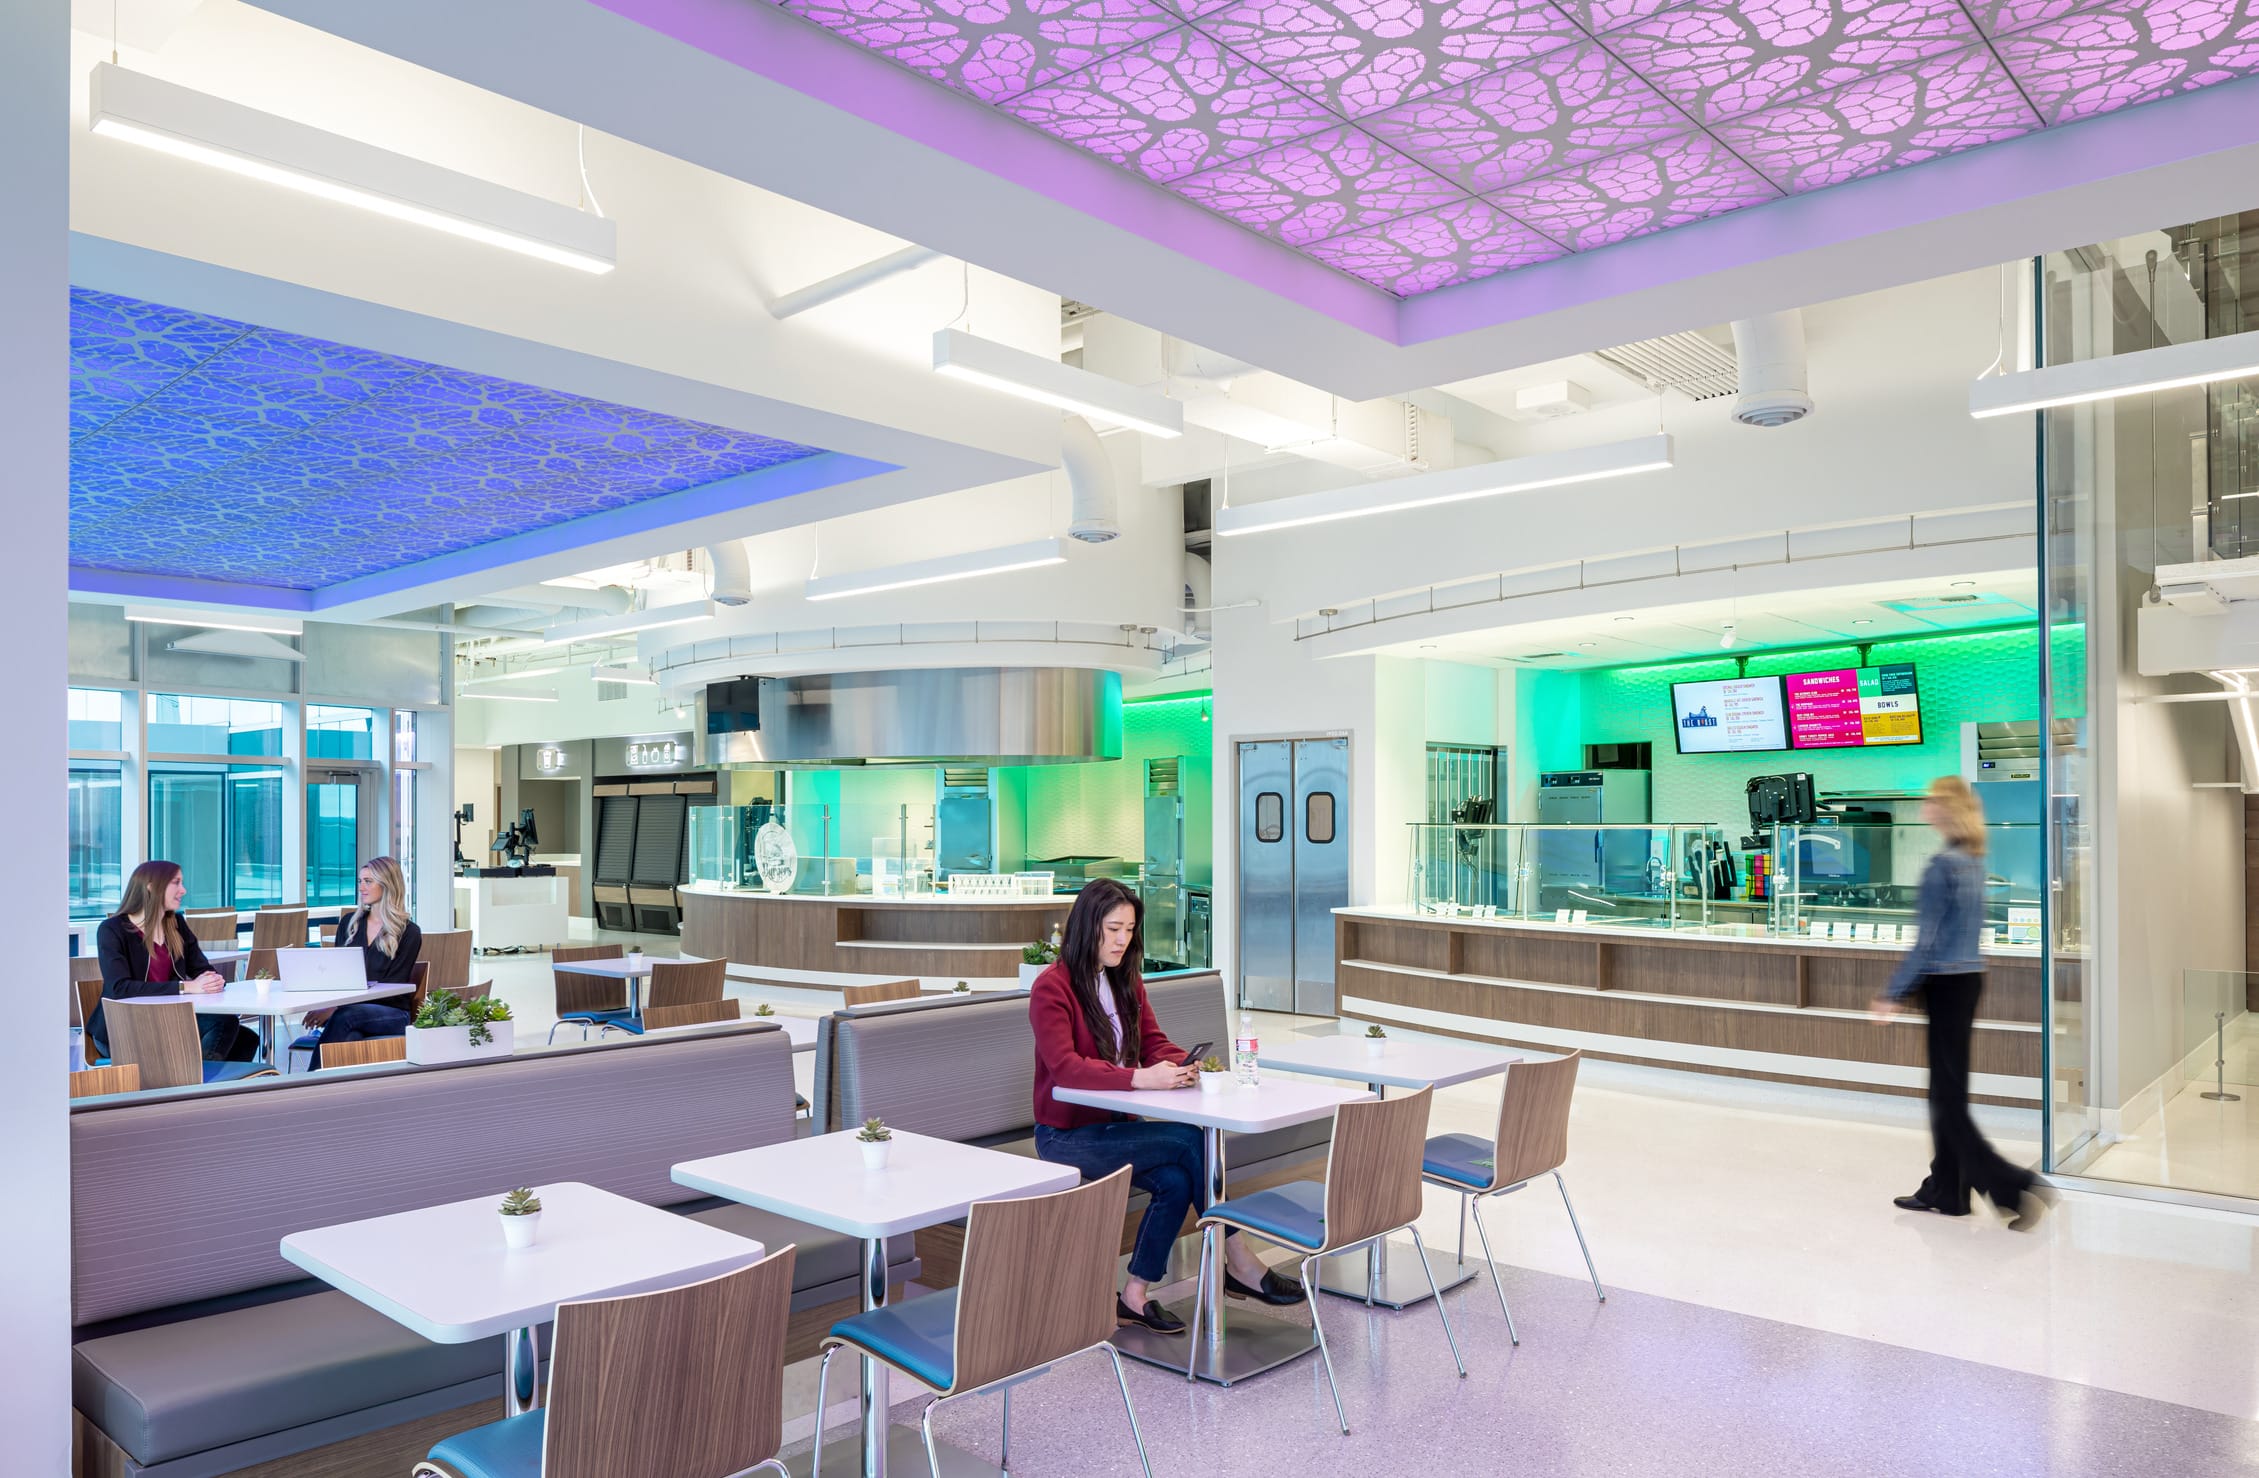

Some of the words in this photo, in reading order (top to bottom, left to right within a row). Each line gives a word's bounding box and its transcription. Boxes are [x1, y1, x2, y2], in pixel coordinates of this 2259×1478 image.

[1802, 676, 1840, 686] SANDWICHES
[1859, 679, 1879, 687] SALAD
[1877, 701, 1899, 709] BOWLS
[1683, 719, 1694, 727] THE
[762, 862, 792, 879] Burgers
